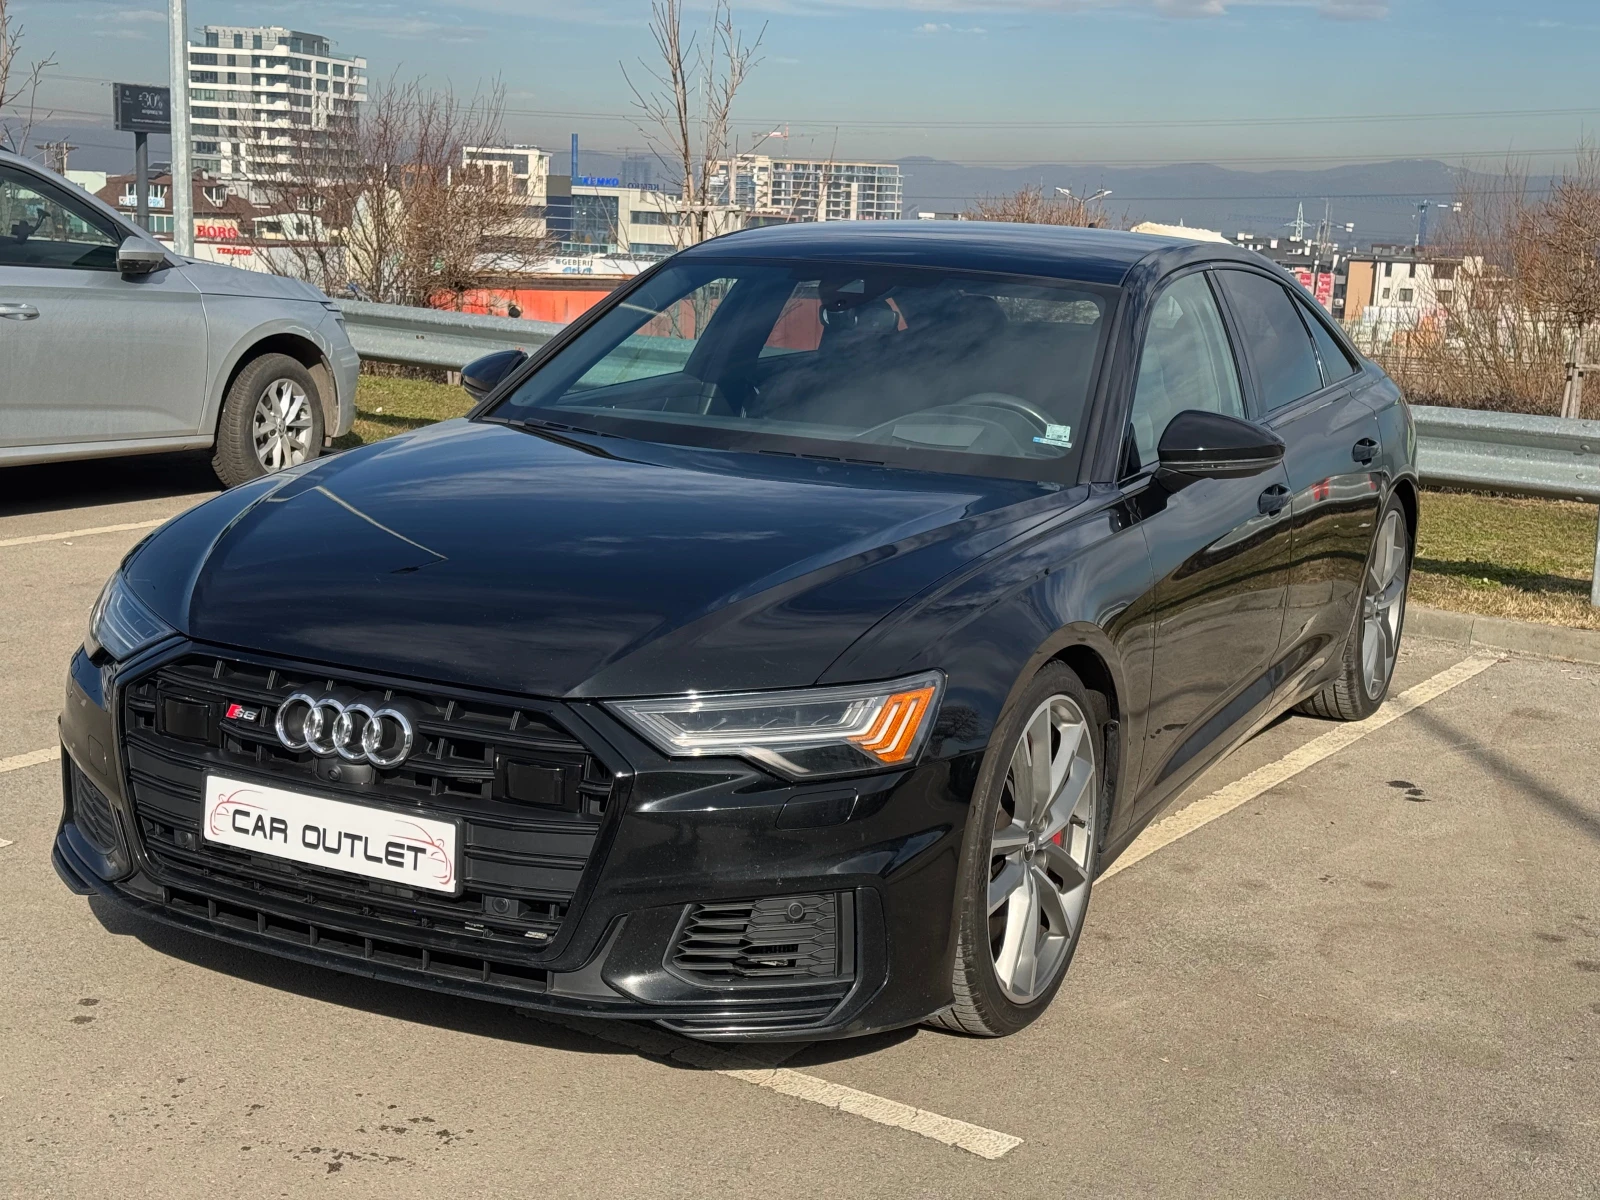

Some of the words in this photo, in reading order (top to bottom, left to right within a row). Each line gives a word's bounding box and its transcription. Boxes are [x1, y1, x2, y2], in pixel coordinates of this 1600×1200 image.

[582, 177, 619, 187] KEMKO
[561, 258, 594, 267] GEBERIT
[231, 808, 288, 844] CAR
[301, 823, 427, 872] OUTLET
